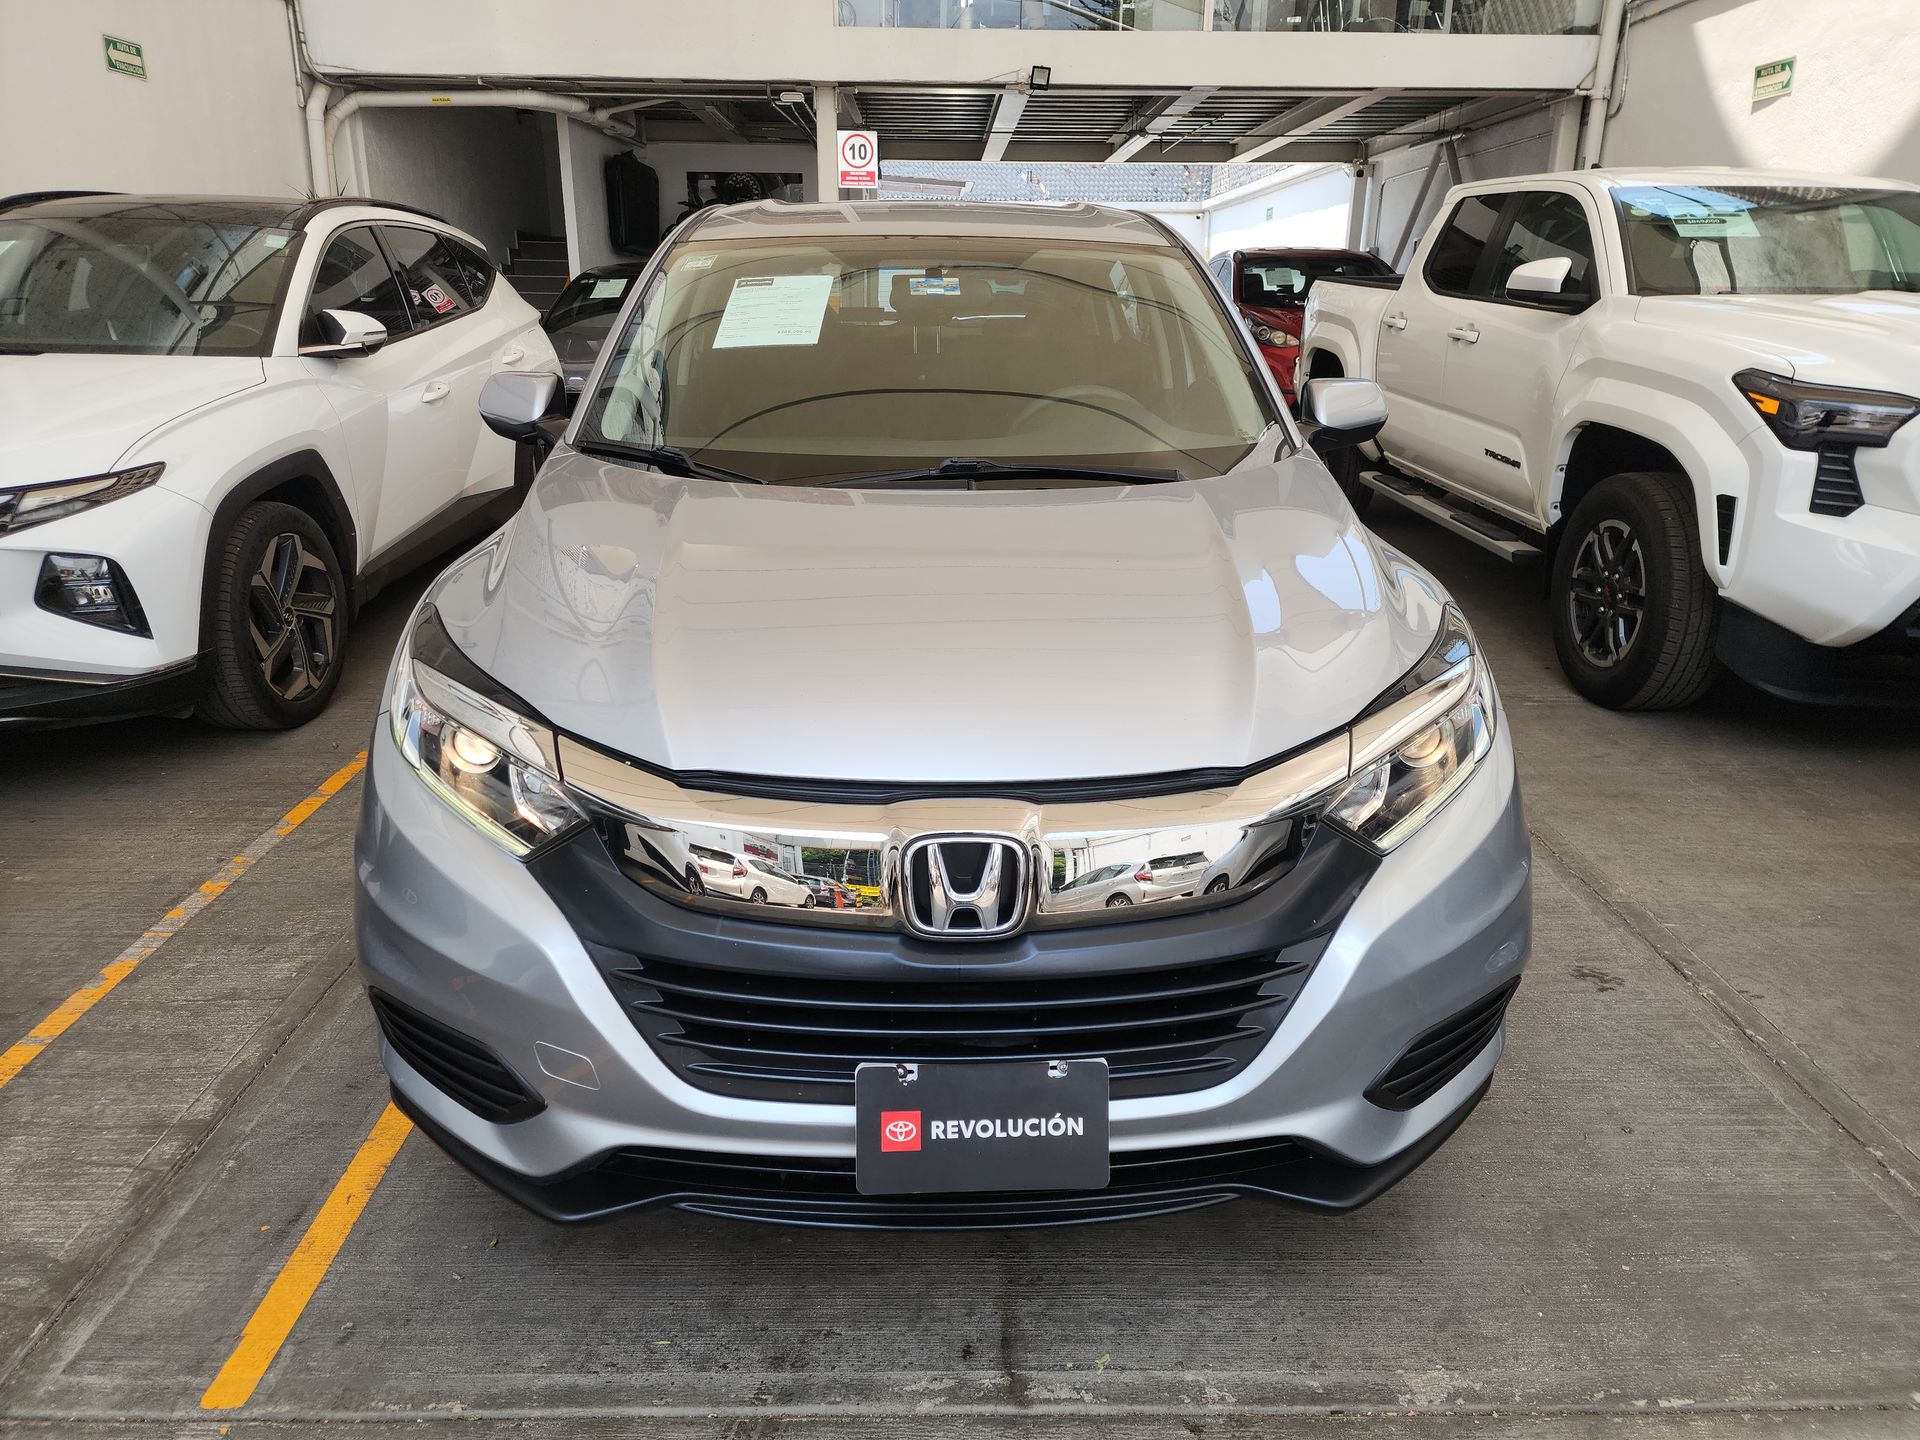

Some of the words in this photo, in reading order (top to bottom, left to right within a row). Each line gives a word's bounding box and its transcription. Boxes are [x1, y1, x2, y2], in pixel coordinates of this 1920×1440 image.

[849, 143, 867, 160] 10
[1484, 448, 1522, 470] TACOMA
[931, 1112, 1084, 1140] REVOLUCIÓN
